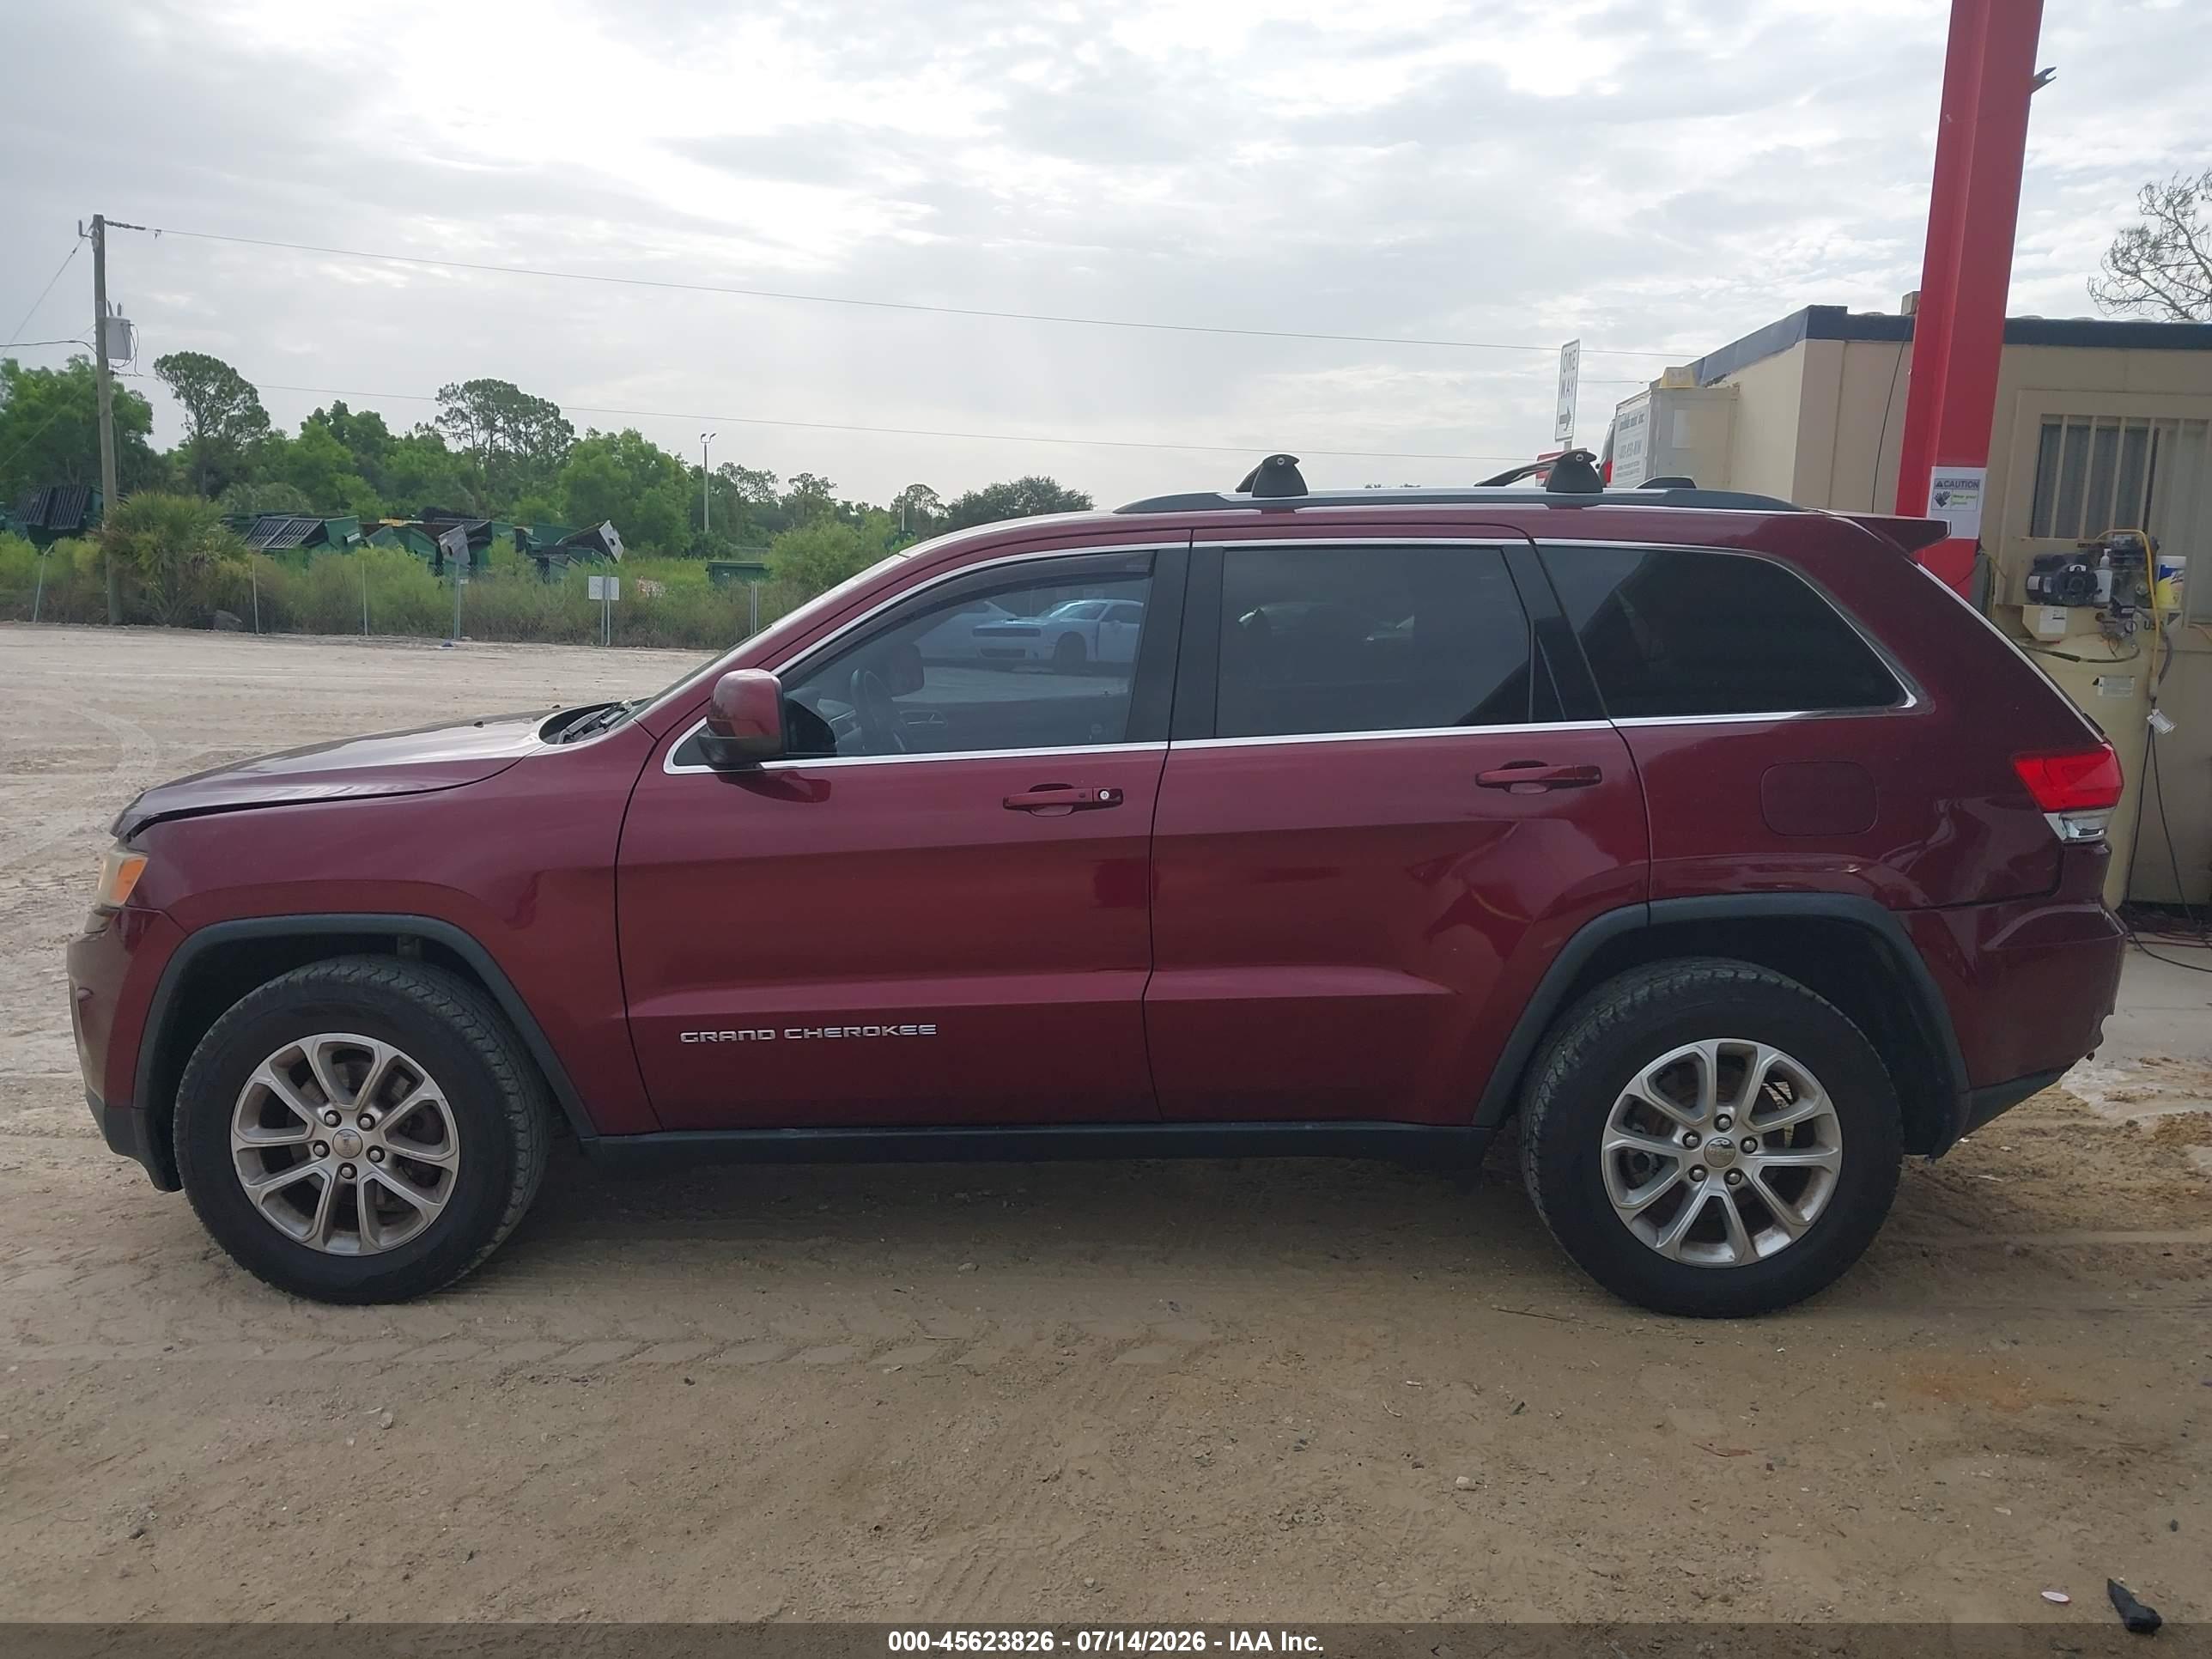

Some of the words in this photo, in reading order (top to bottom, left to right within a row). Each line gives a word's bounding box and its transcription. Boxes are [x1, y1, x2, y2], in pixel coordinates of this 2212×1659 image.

[1563, 349, 1577, 373] ONE
[1560, 376, 1575, 398] WAY
[1944, 480, 1978, 489] CAUTION
[680, 1030, 776, 1042] GRAND
[784, 1024, 937, 1039] CHEROKEE
